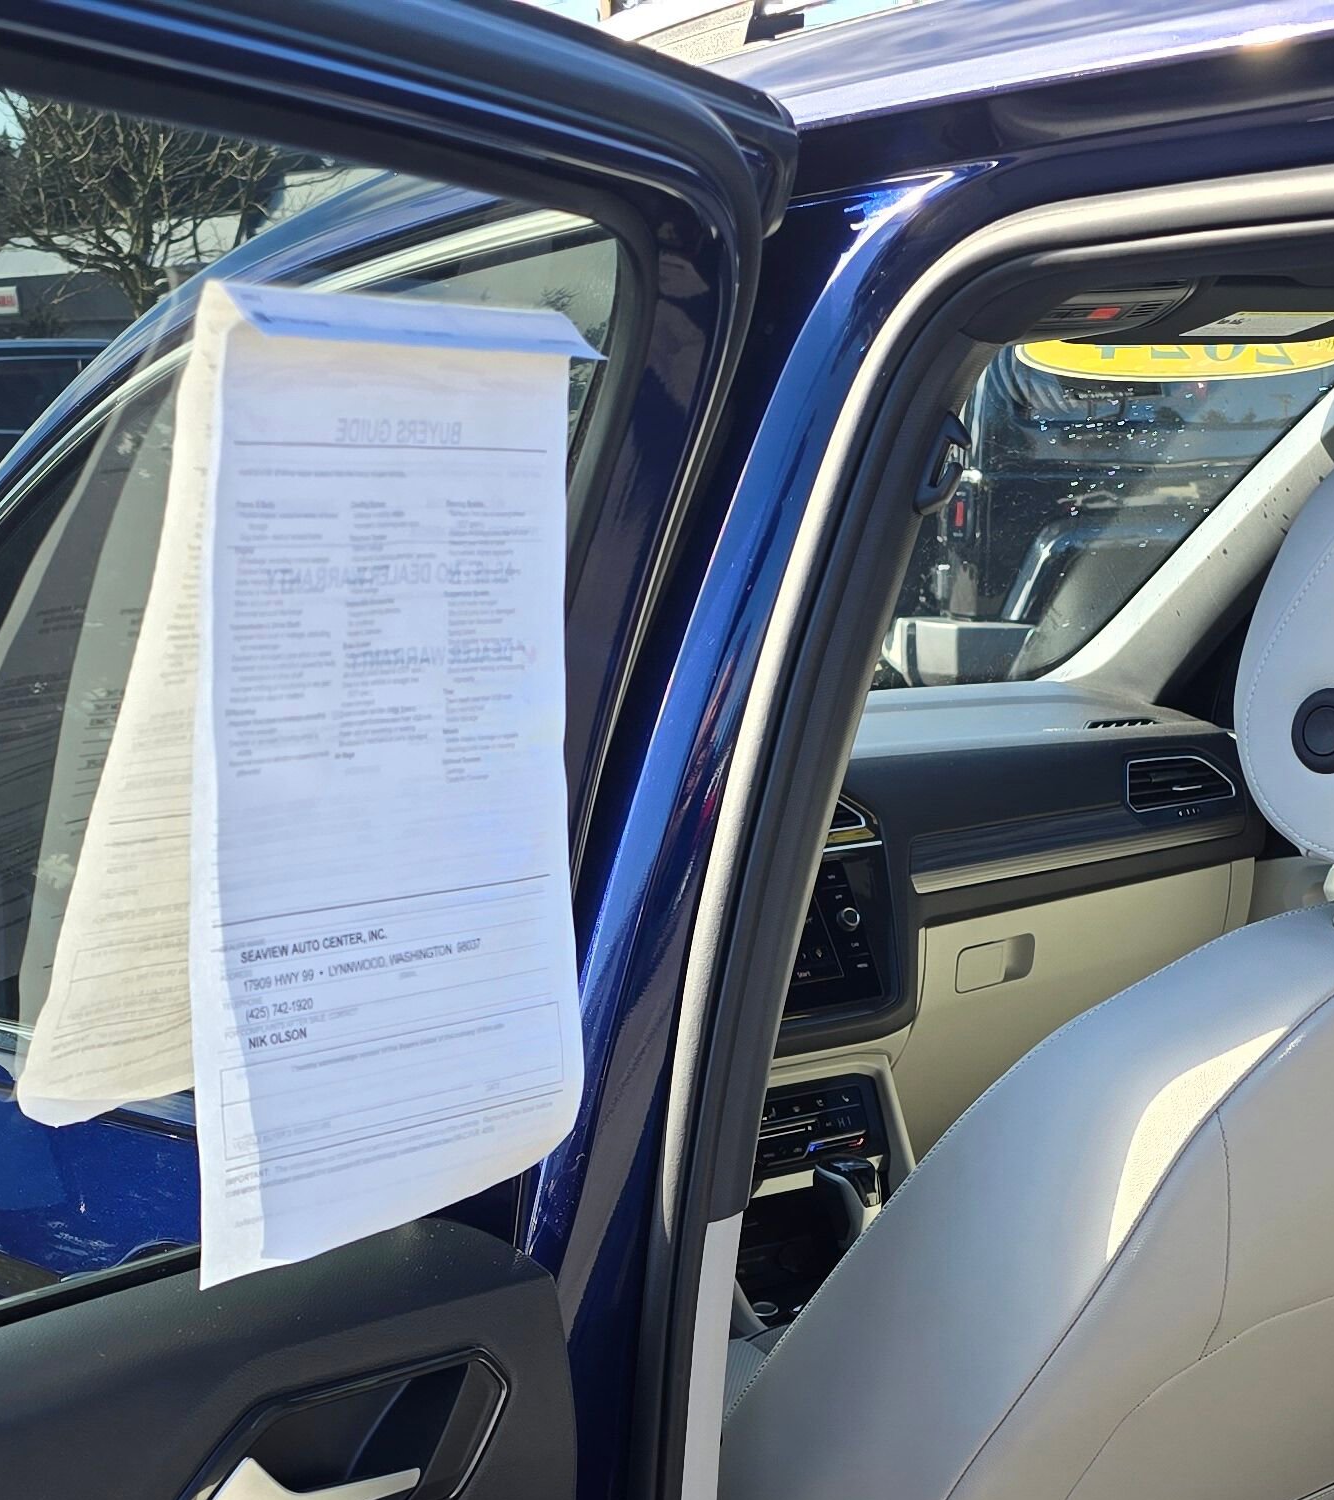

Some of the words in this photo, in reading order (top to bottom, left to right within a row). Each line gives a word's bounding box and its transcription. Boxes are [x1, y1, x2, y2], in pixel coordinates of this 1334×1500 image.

[240, 945, 290, 964] SEAVIEW
[291, 939, 320, 955] AUTO
[322, 932, 366, 950] CENTER,
[368, 928, 388, 942] INC.
[243, 977, 272, 993] 17909
[274, 970, 300, 987] HWY
[301, 968, 315, 983] 99
[327, 956, 387, 977] LYNNWOOD,
[388, 943, 453, 967] WASHINGTON
[245, 1006, 270, 1024] (425)
[272, 998, 314, 1017] 742-1920
[247, 1035, 268, 1050] NIK
[269, 1027, 308, 1045] OLSON
